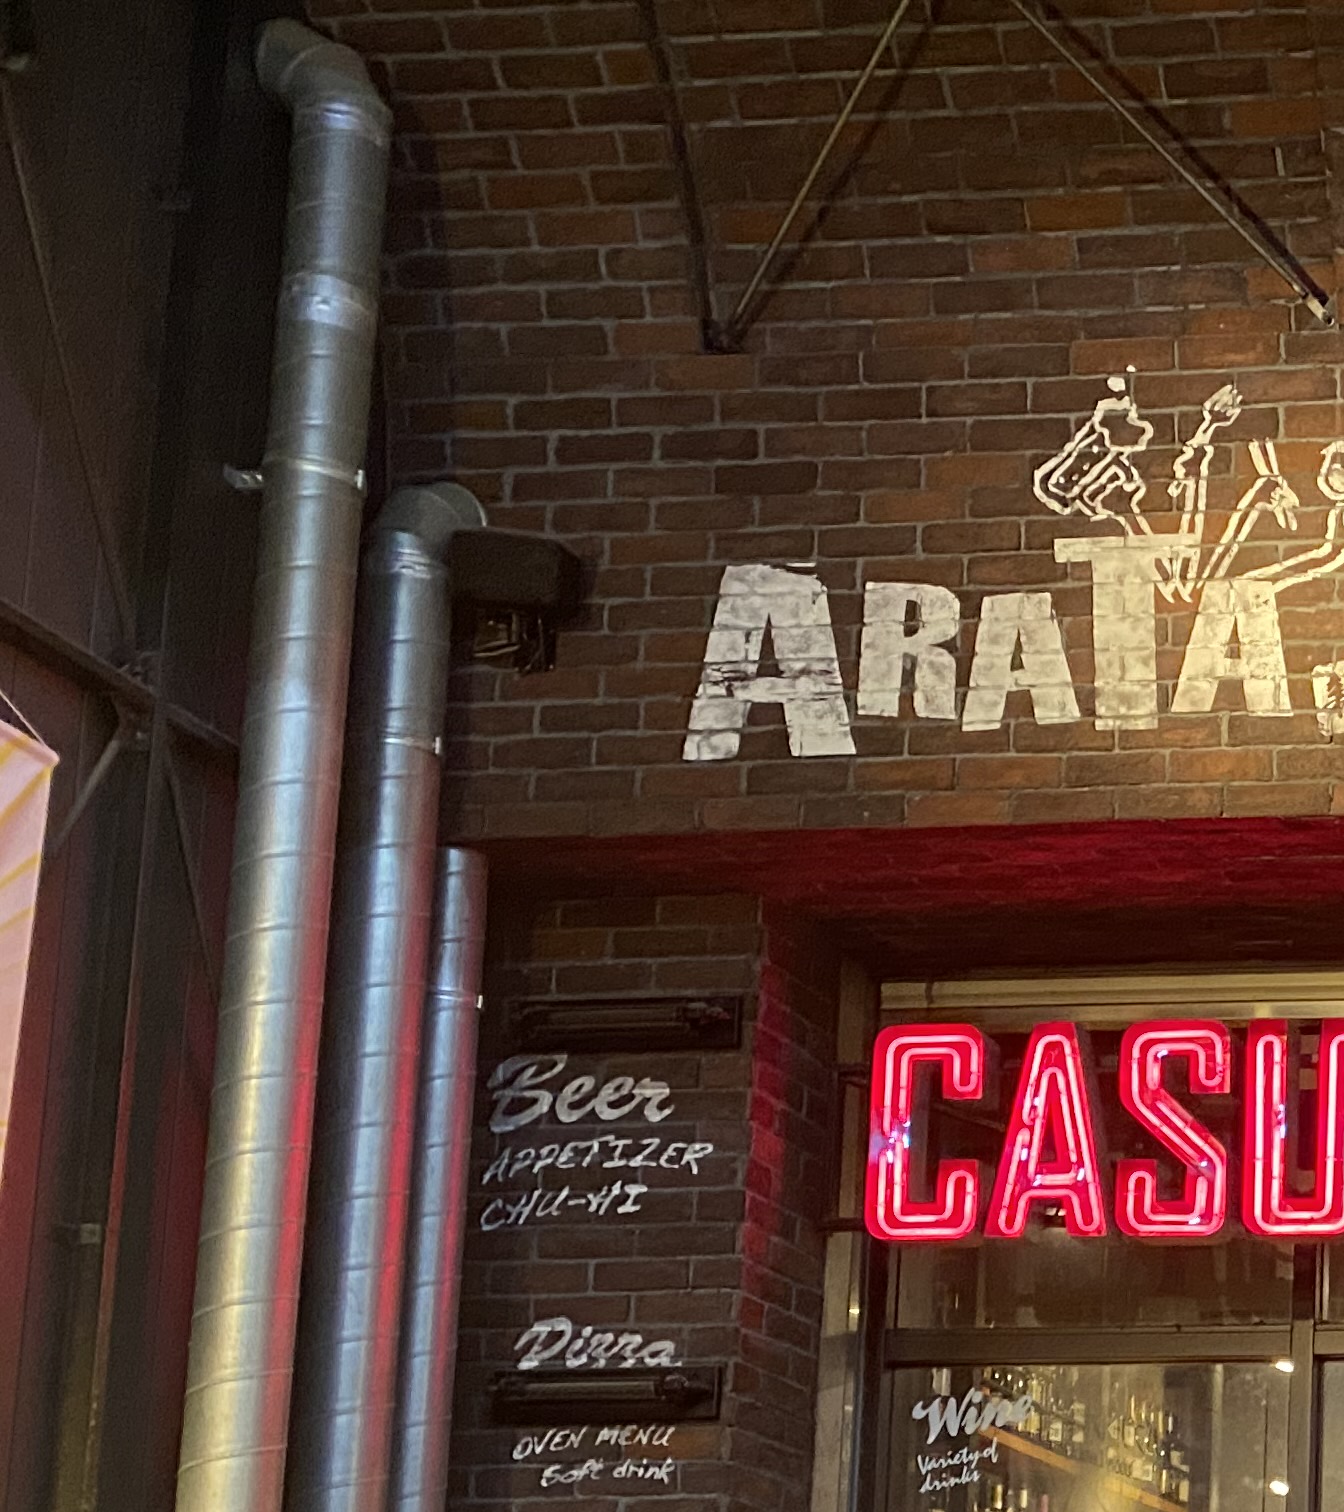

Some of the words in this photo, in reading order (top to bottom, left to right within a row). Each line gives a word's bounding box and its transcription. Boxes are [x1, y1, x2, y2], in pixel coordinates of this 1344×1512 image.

[682, 534, 1294, 761] ARATA
[486, 1054, 675, 1132] Beer
[481, 1138, 715, 1185] APPETIZER
[480, 1181, 648, 1231] CHU-HI
[513, 1317, 682, 1370] Pizza
[912, 1387, 1032, 1444] Wine
[512, 1428, 585, 1460] OVEN
[599, 1424, 675, 1448] MENU
[612, 1459, 677, 1484] drink
[919, 1466, 981, 1494] drinks
